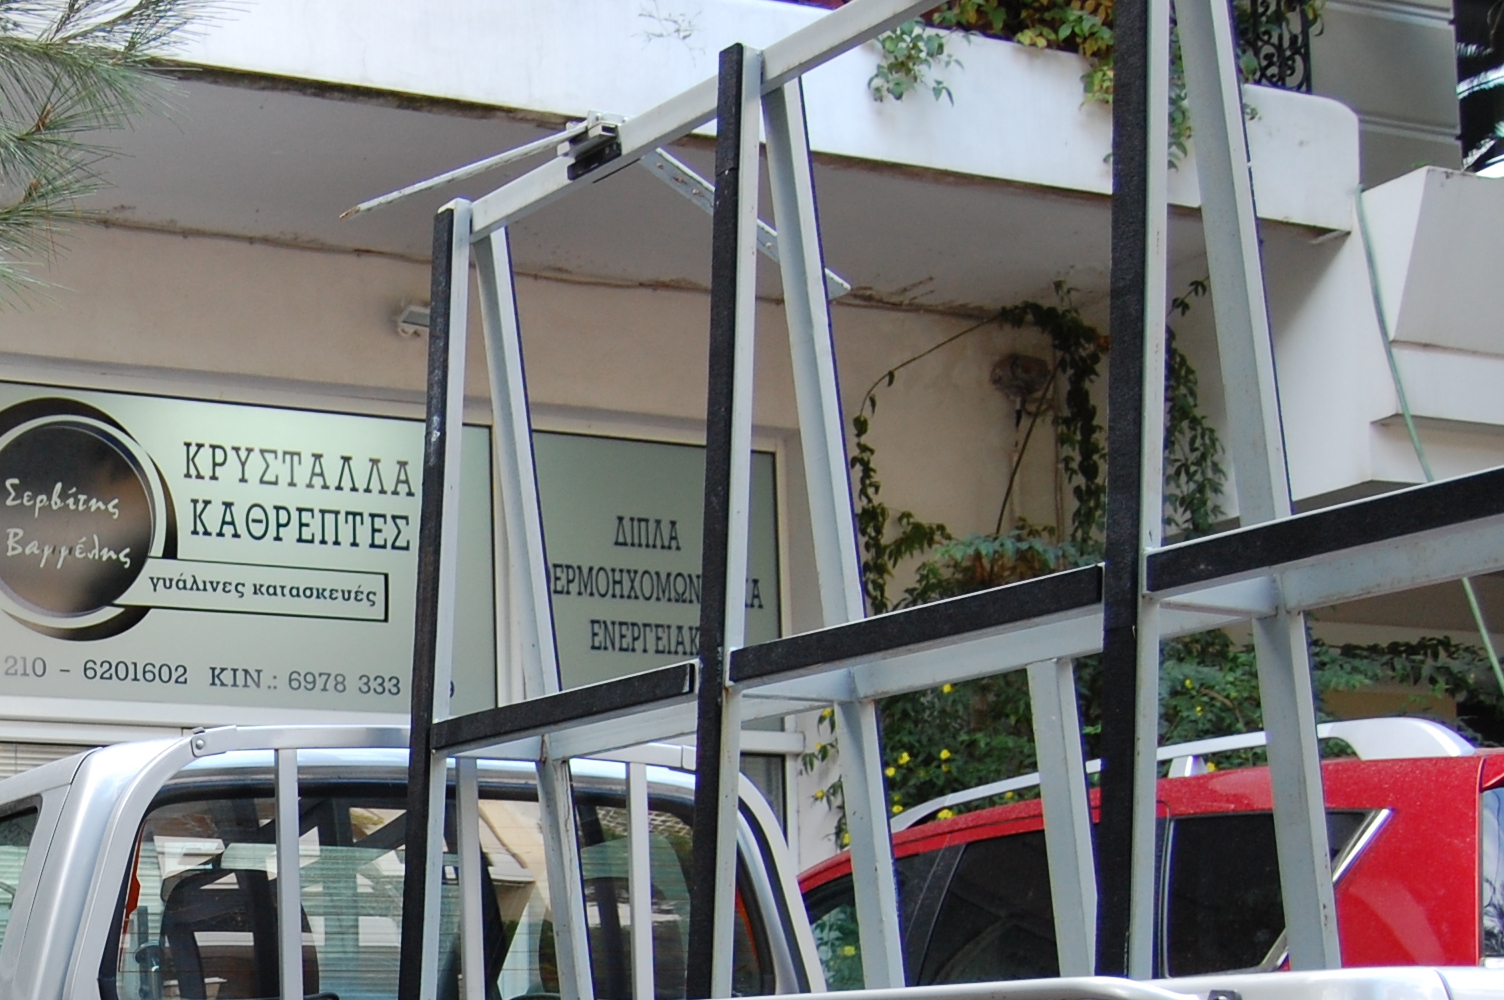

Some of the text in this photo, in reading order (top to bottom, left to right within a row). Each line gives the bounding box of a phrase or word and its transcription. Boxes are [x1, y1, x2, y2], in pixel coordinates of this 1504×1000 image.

[183, 441, 415, 497] ΚΡΥΣΤΑΛΛΑ
[190, 498, 412, 551] ΚΑΘΡΕΠΤΕΣ
[614, 515, 682, 551] ΔΙΠΛΑ
[148, 573, 377, 606] γυάλινες κατασκευές
[590, 619, 701, 656] ΕΝΕΡΓΕΙΑΚ
[3, 655, 47, 678] 210
[82, 658, 189, 685] 6201602
[287, 671, 348, 694] 6978
[357, 674, 401, 697] 333
